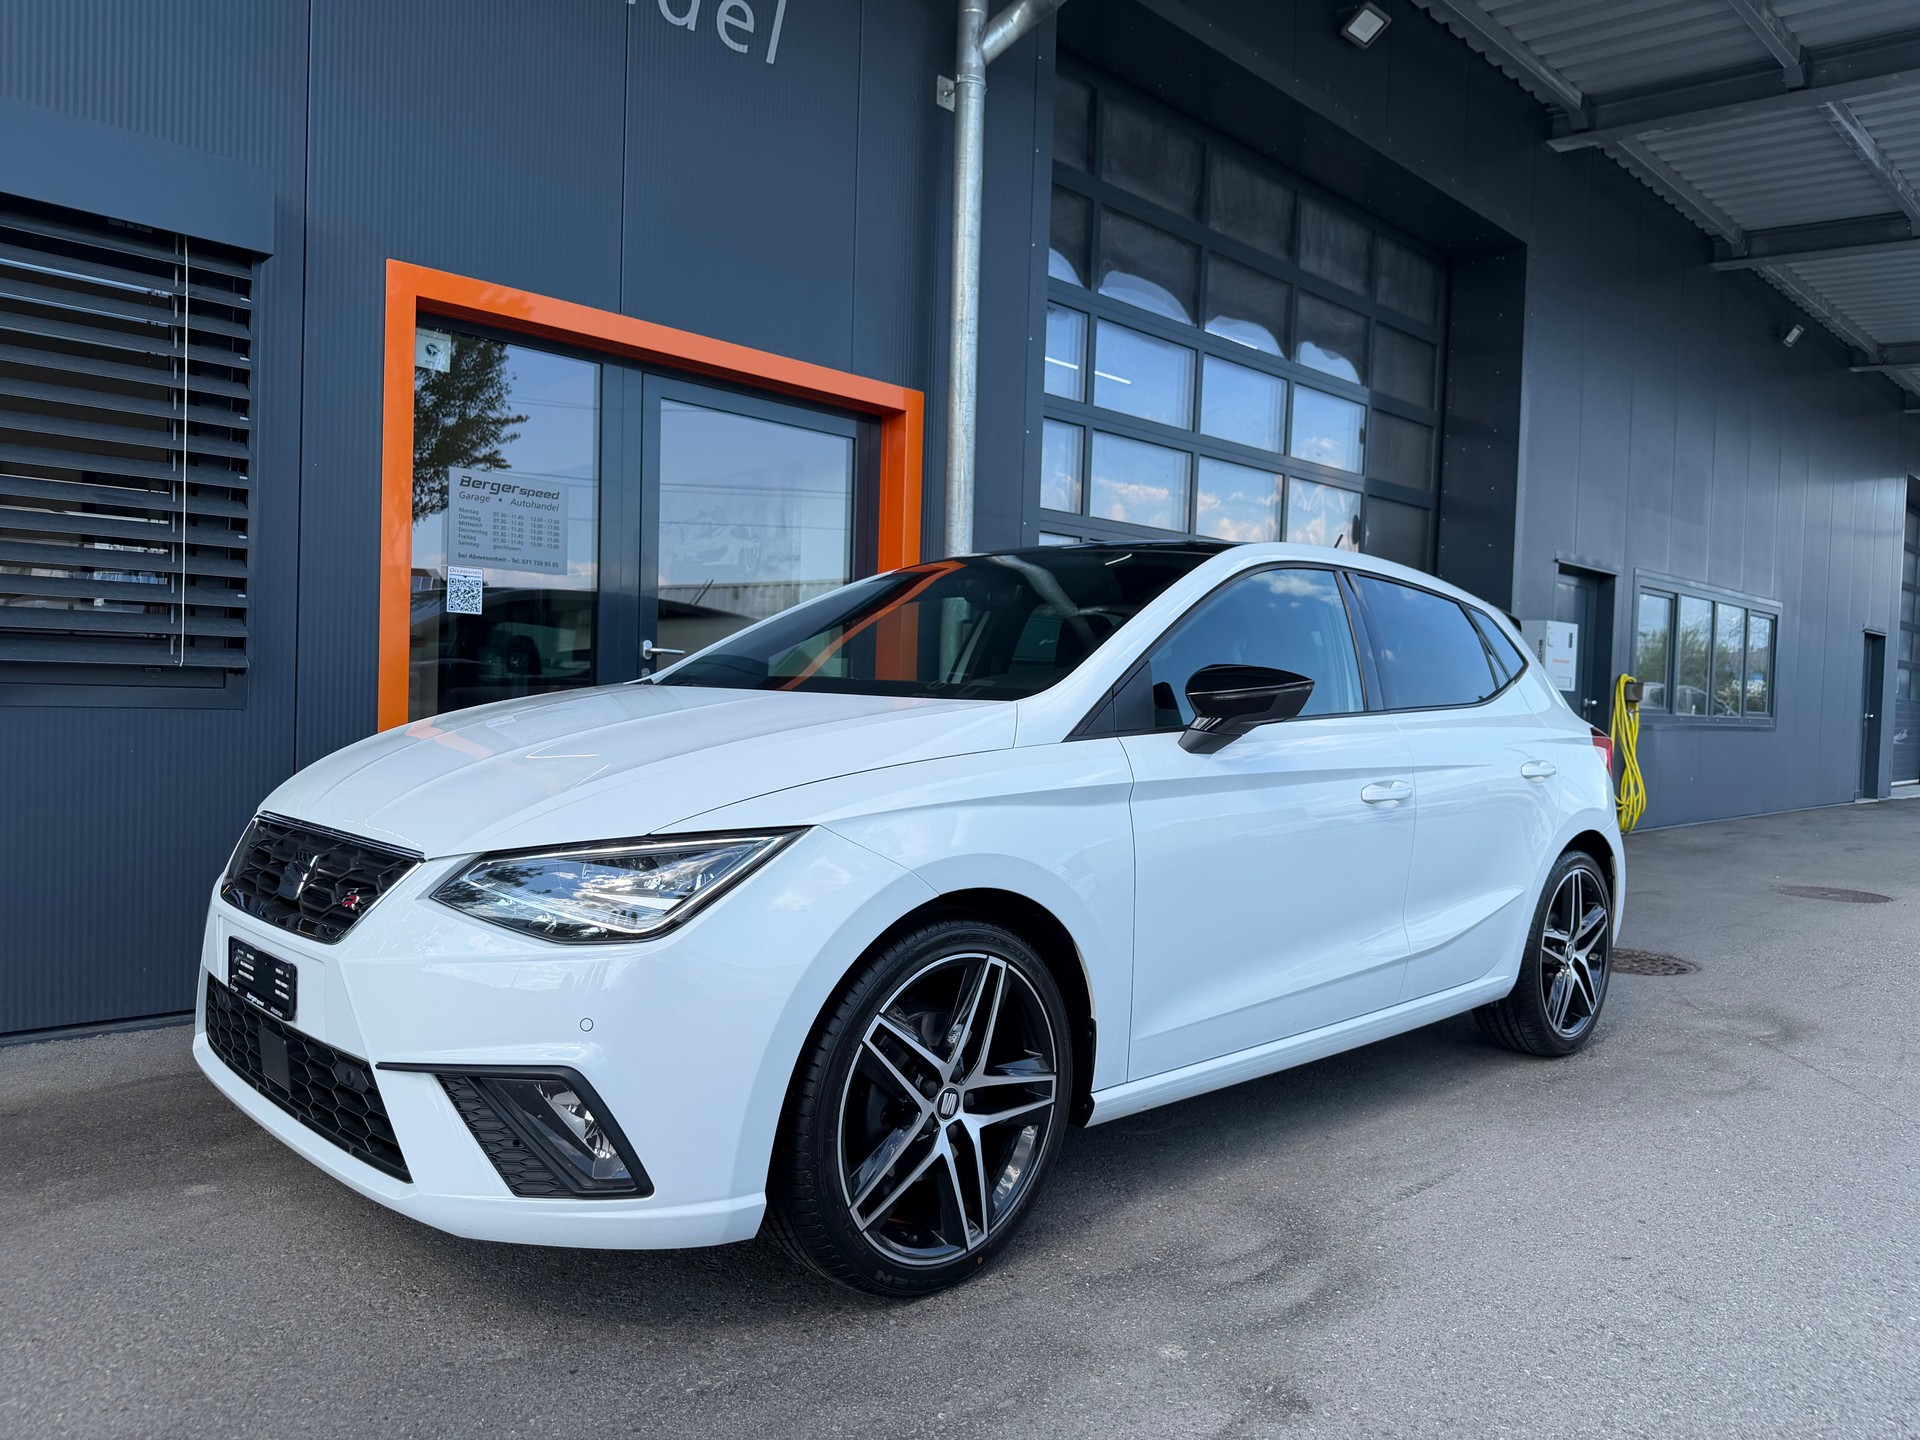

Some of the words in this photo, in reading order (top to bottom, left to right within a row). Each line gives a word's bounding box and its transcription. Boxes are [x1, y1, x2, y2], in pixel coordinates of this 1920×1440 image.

[460, 476, 560, 500] Bergerspeed
[459, 491, 490, 504] Garage
[510, 498, 560, 512] Autohandel
[459, 507, 479, 516] Montag
[459, 514, 481, 522] Dienstag
